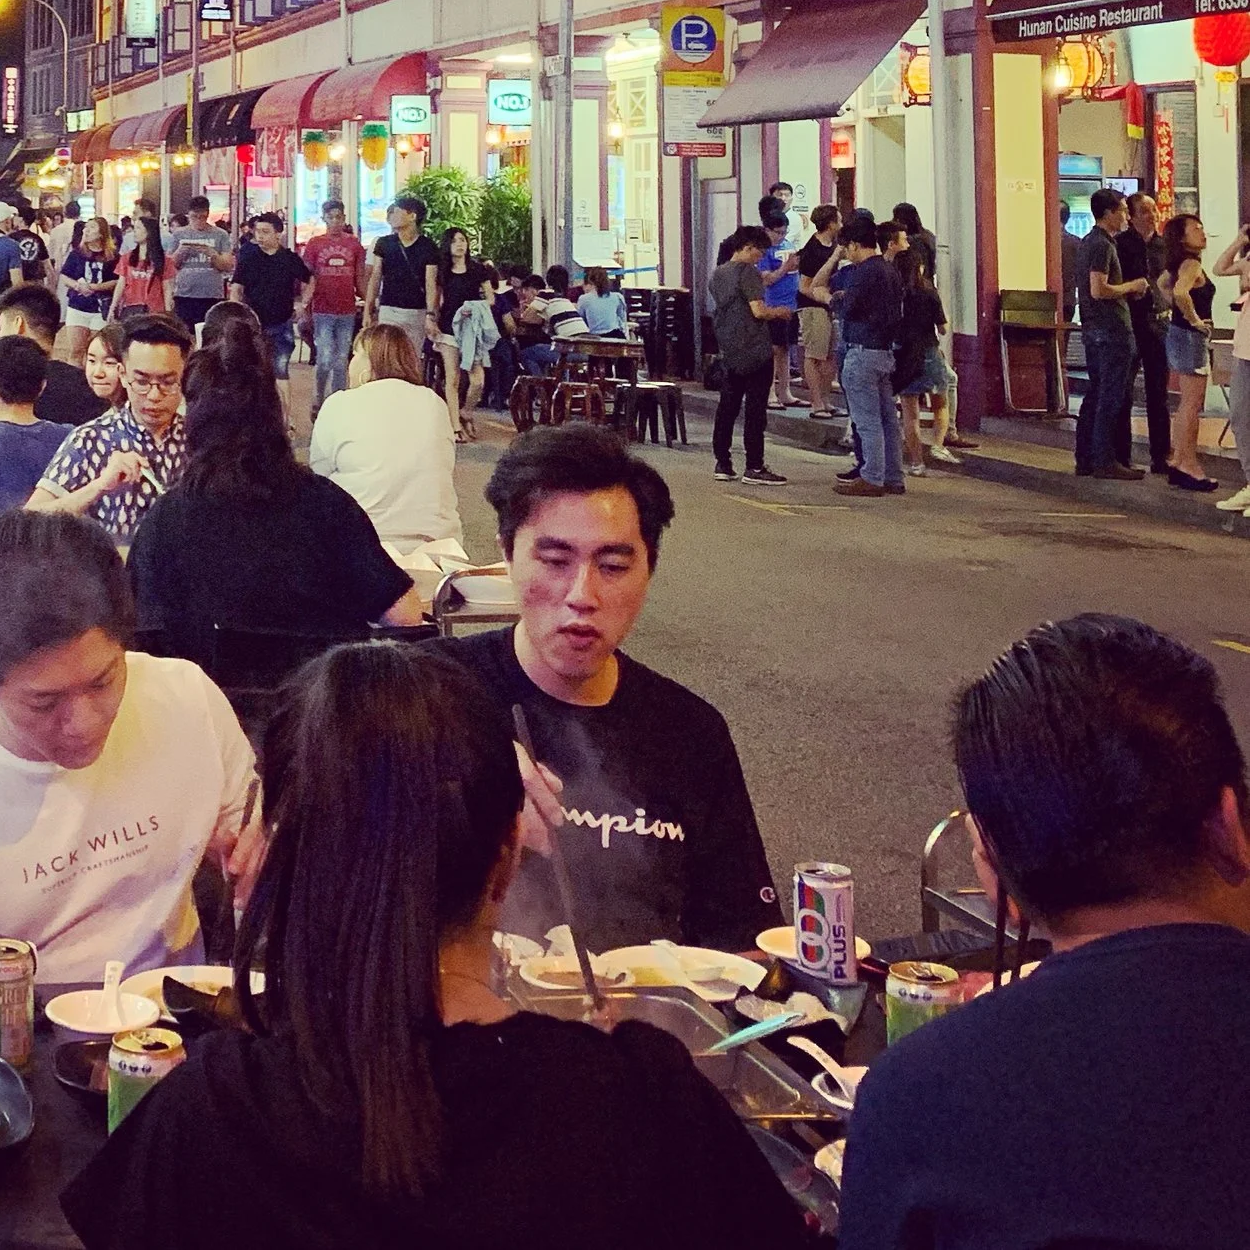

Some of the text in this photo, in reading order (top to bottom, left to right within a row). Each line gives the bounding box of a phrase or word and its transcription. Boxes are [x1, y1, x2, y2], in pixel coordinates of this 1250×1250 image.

[681, 19, 708, 50] P
[1018, 1, 1164, 38] Hunan Cuisine Restaurant
[560, 807, 685, 849] mpion
[23, 815, 160, 884] JACK WILLS
[833, 924, 847, 980] PLUS
